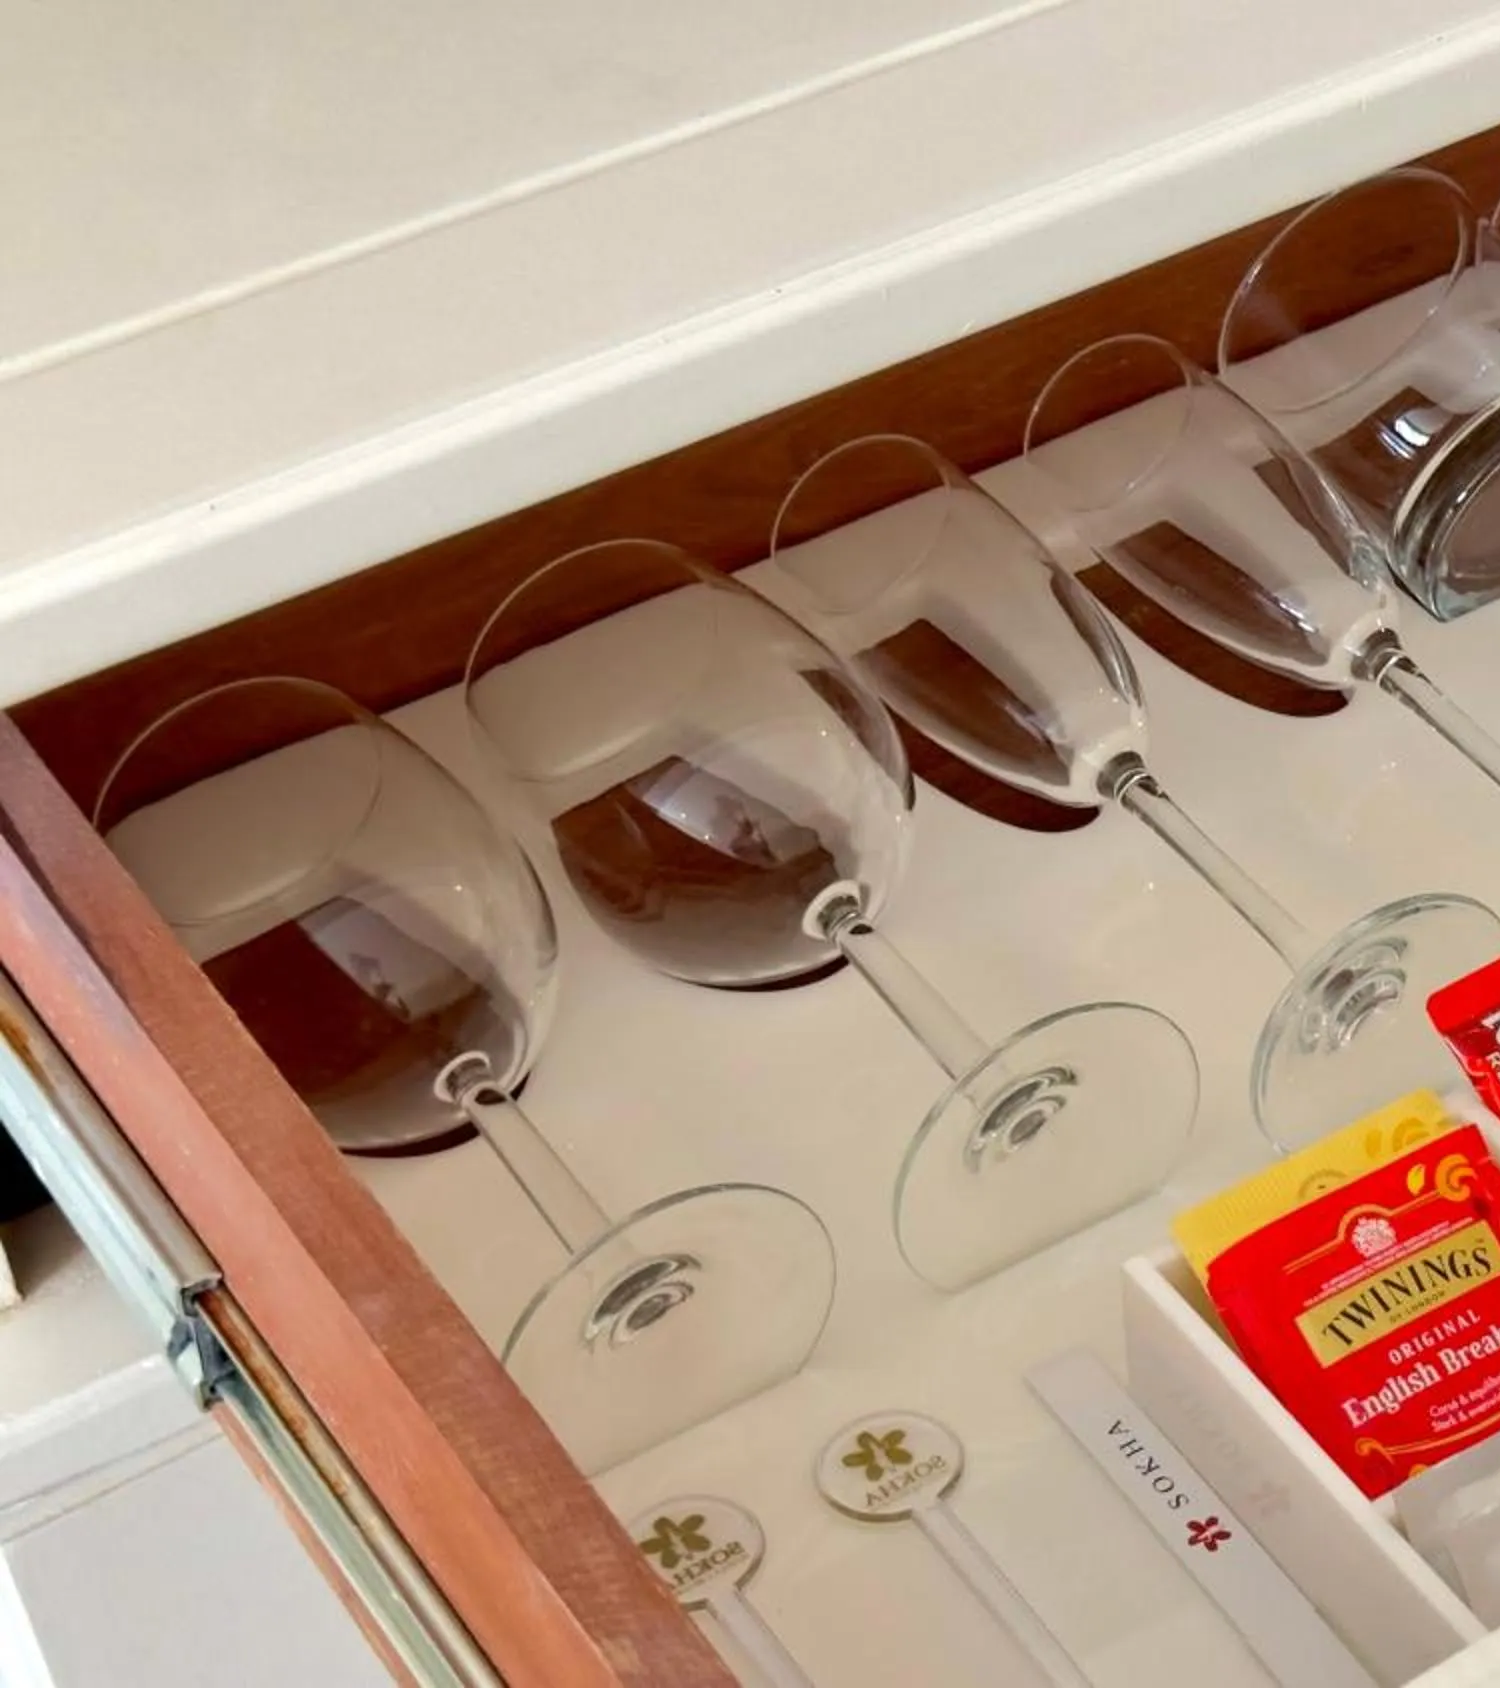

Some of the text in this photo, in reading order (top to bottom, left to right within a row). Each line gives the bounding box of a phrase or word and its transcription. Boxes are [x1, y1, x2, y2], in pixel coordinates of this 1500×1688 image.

[1322, 1246, 1492, 1346] TWININGS
[1387, 1308, 1481, 1366] ORIGINAL
[1340, 1361, 1442, 1428] English
[1107, 1420, 1189, 1510] SOKHA
